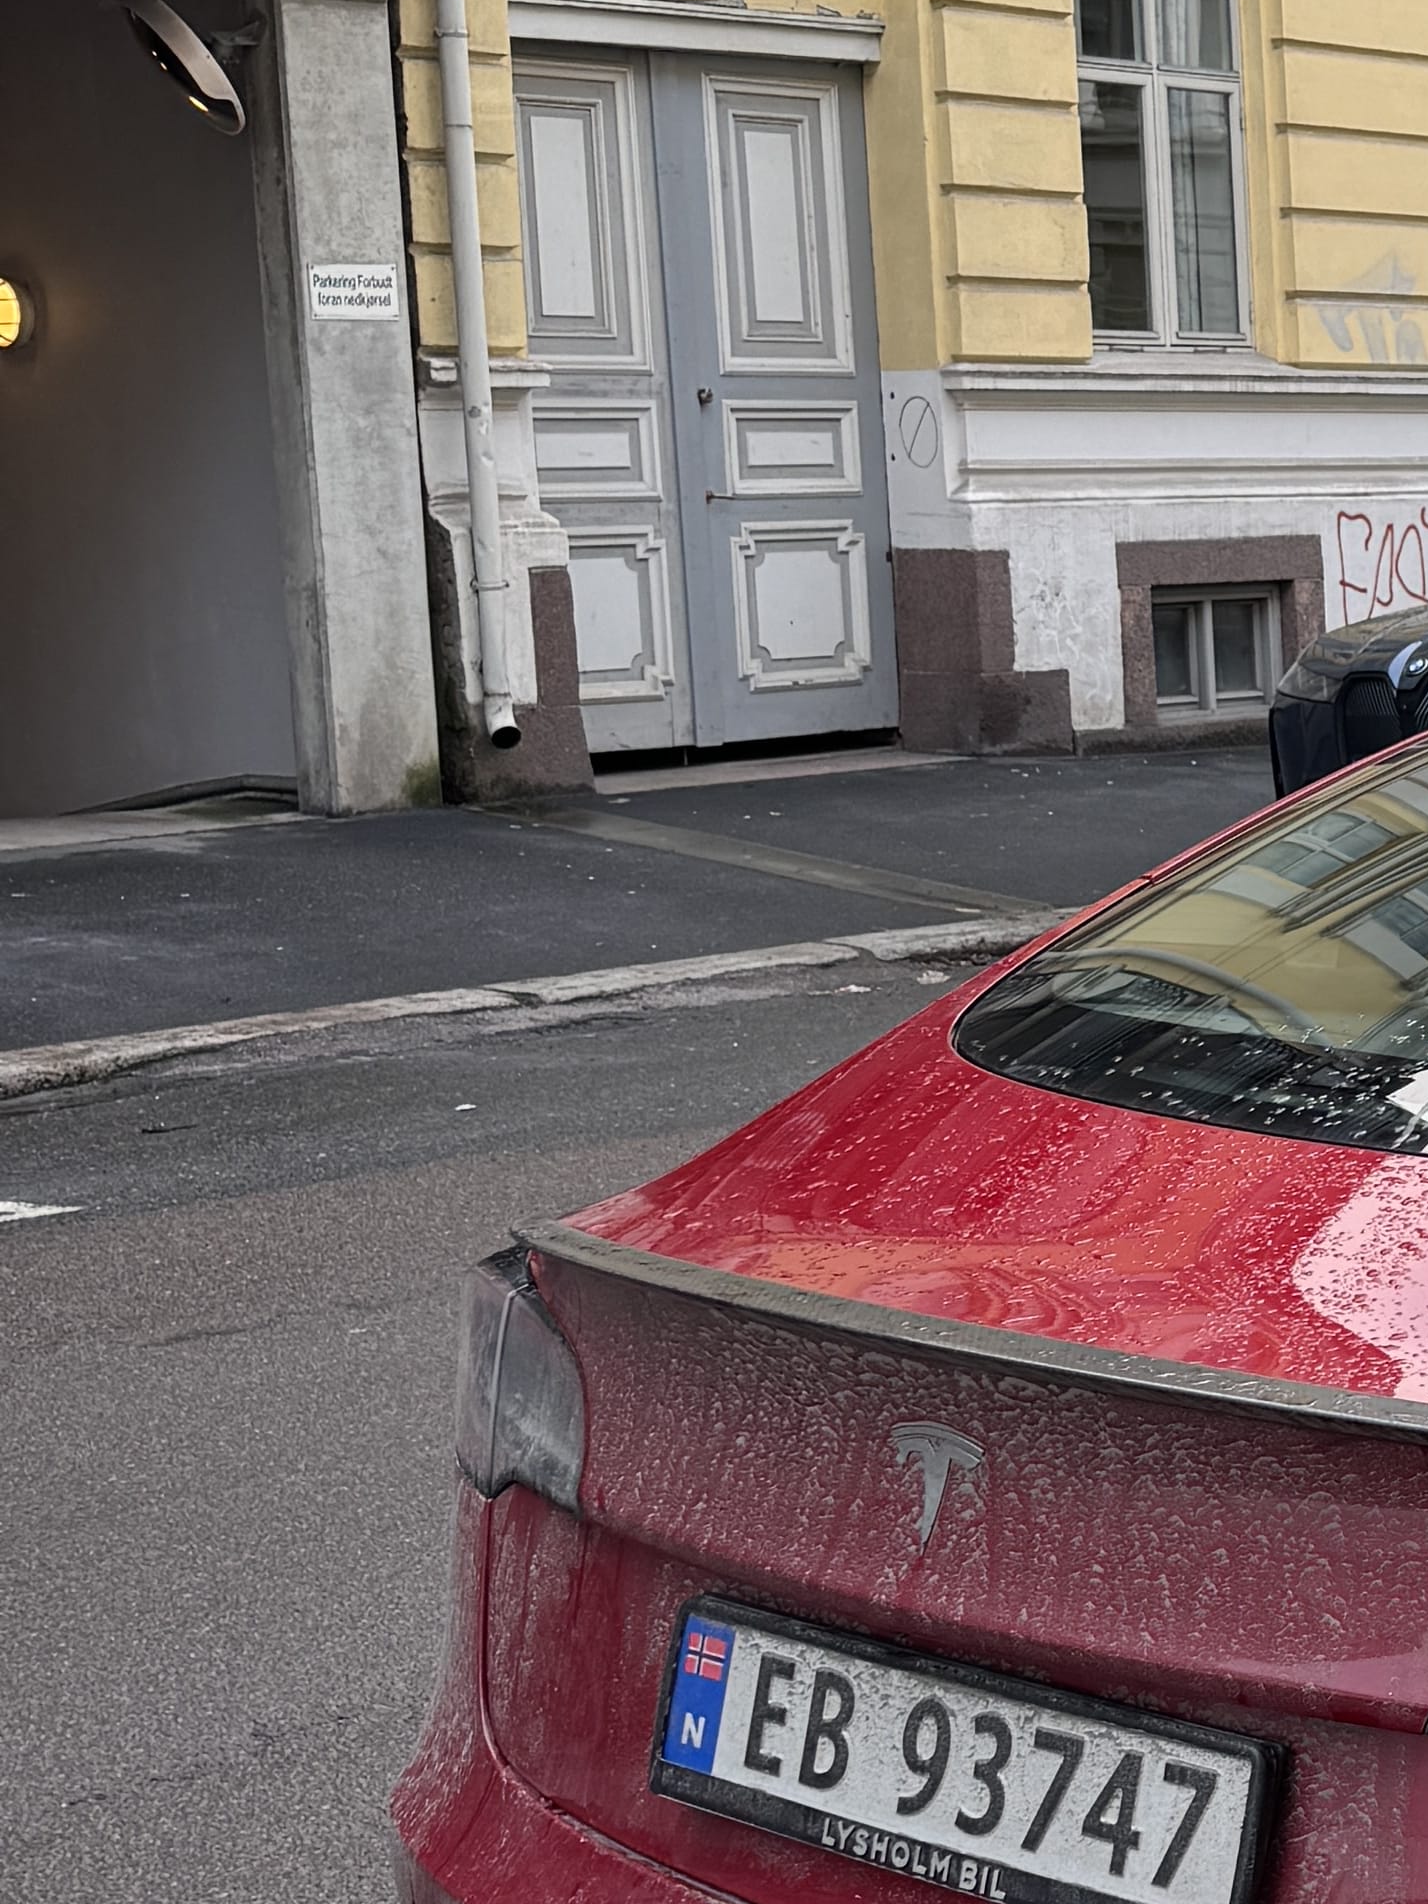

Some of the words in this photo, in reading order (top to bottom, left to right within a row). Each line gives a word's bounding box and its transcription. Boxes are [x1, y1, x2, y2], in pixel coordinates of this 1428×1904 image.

[312, 273, 356, 291] Parkering
[680, 1711, 706, 1749] N
[743, 1650, 856, 1790] EB
[896, 1696, 1221, 1889] 93747
[820, 1817, 953, 1882] LYSHOLM
[957, 1859, 1007, 1901] BIL
